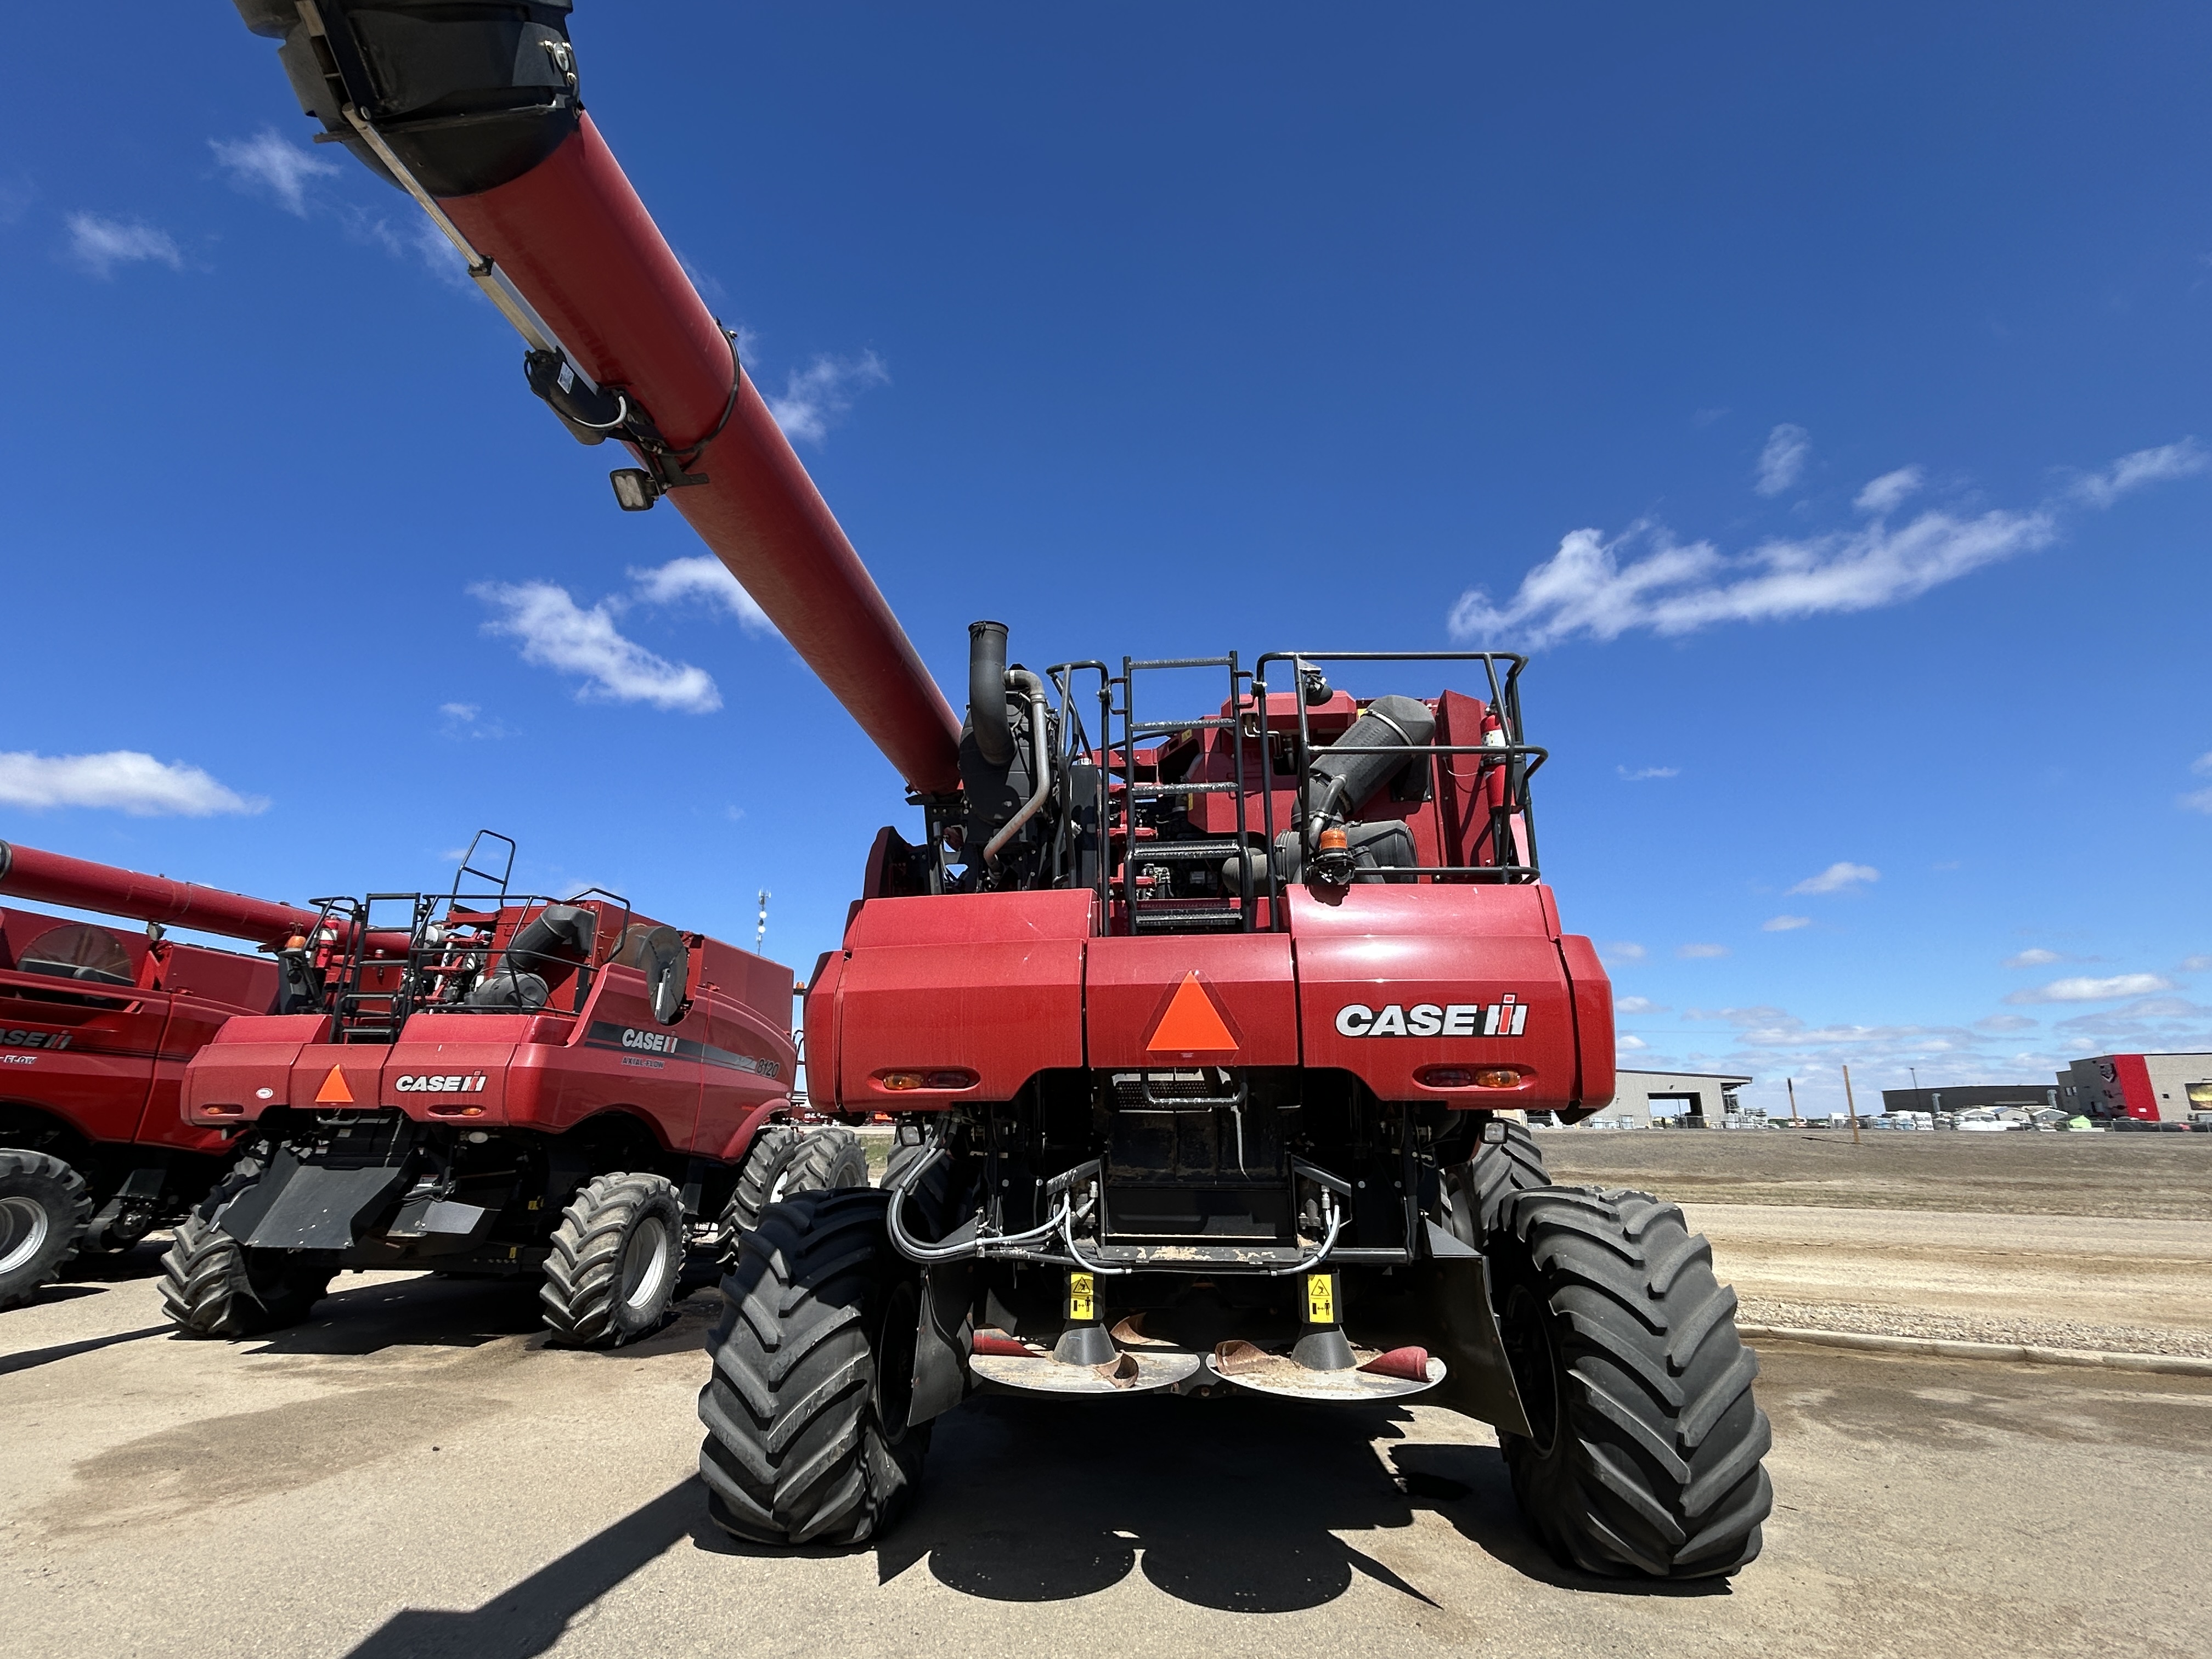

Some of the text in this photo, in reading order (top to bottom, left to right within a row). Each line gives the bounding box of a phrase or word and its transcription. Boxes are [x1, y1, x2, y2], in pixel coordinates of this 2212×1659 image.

[1335, 1004, 1478, 1036] CASE
[622, 1029, 664, 1051] CASE
[622, 1056, 665, 1069] AXIAL-FLOW
[757, 1058, 780, 1079] 8120
[396, 1075, 462, 1091] CASE
